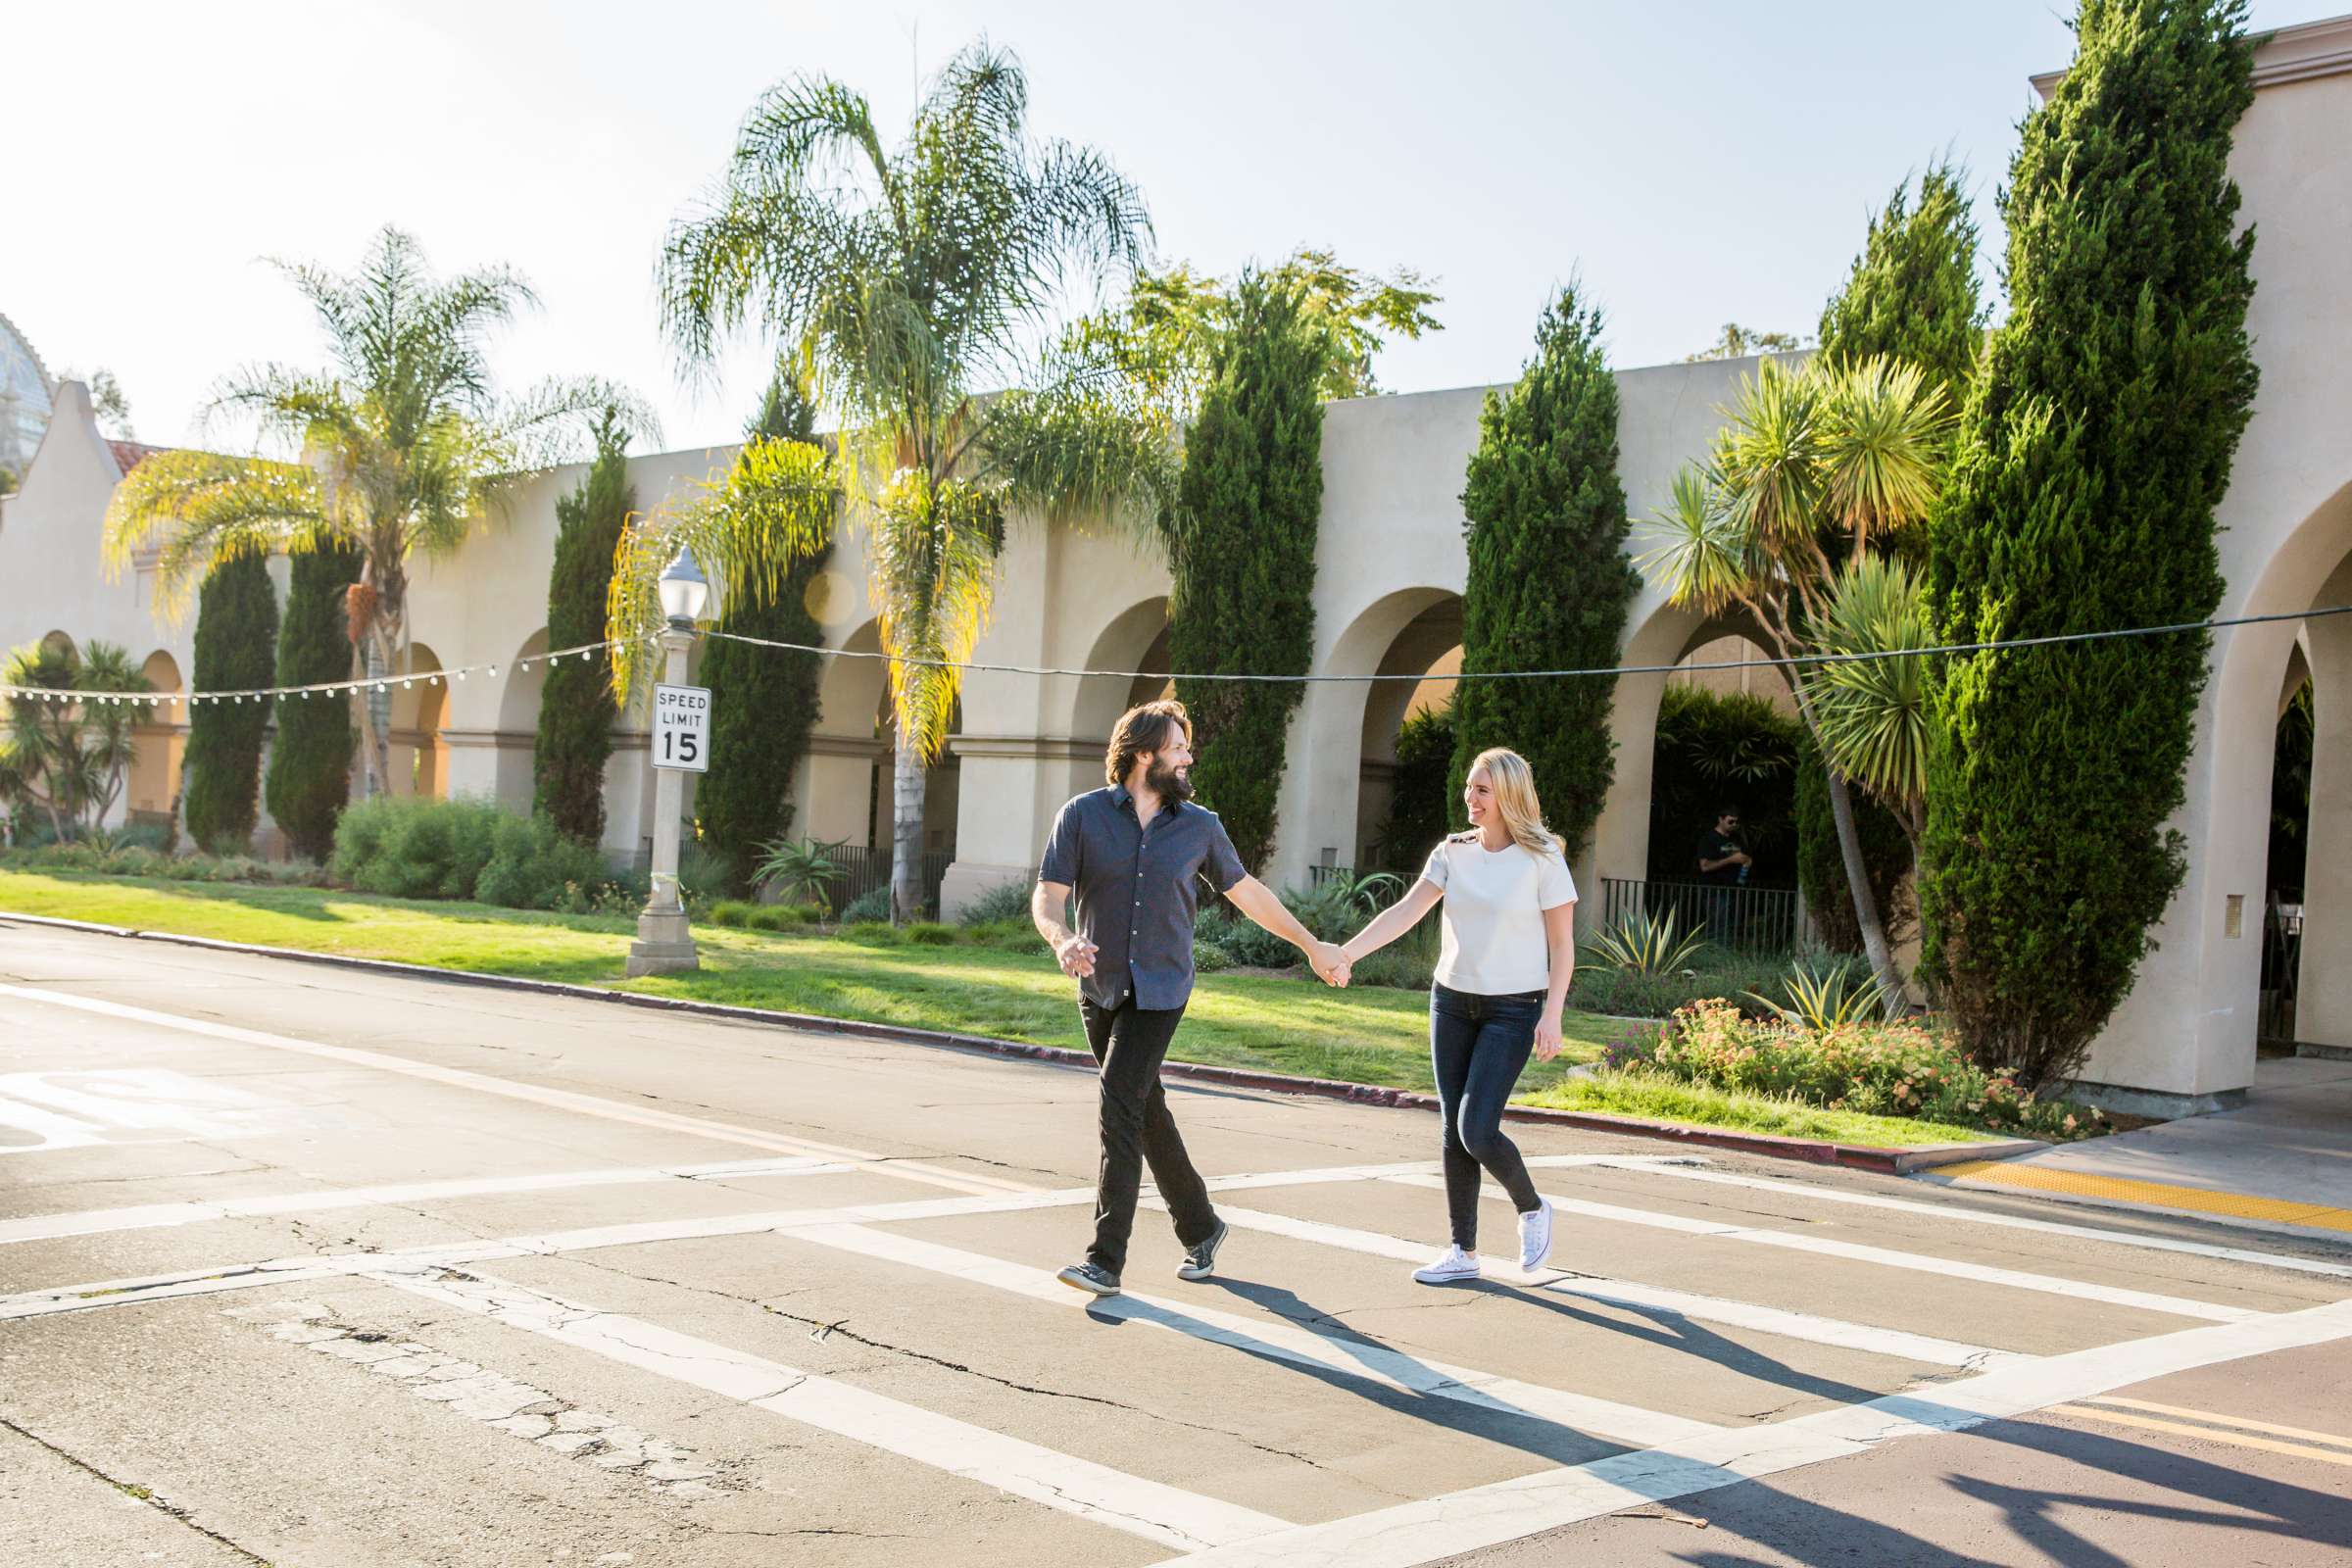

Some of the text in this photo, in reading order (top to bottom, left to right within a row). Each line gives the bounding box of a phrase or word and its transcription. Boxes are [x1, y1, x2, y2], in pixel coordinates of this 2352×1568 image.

[659, 693, 706, 710] SPEED
[662, 711, 702, 727] LIMIT
[664, 731, 698, 762] 15
